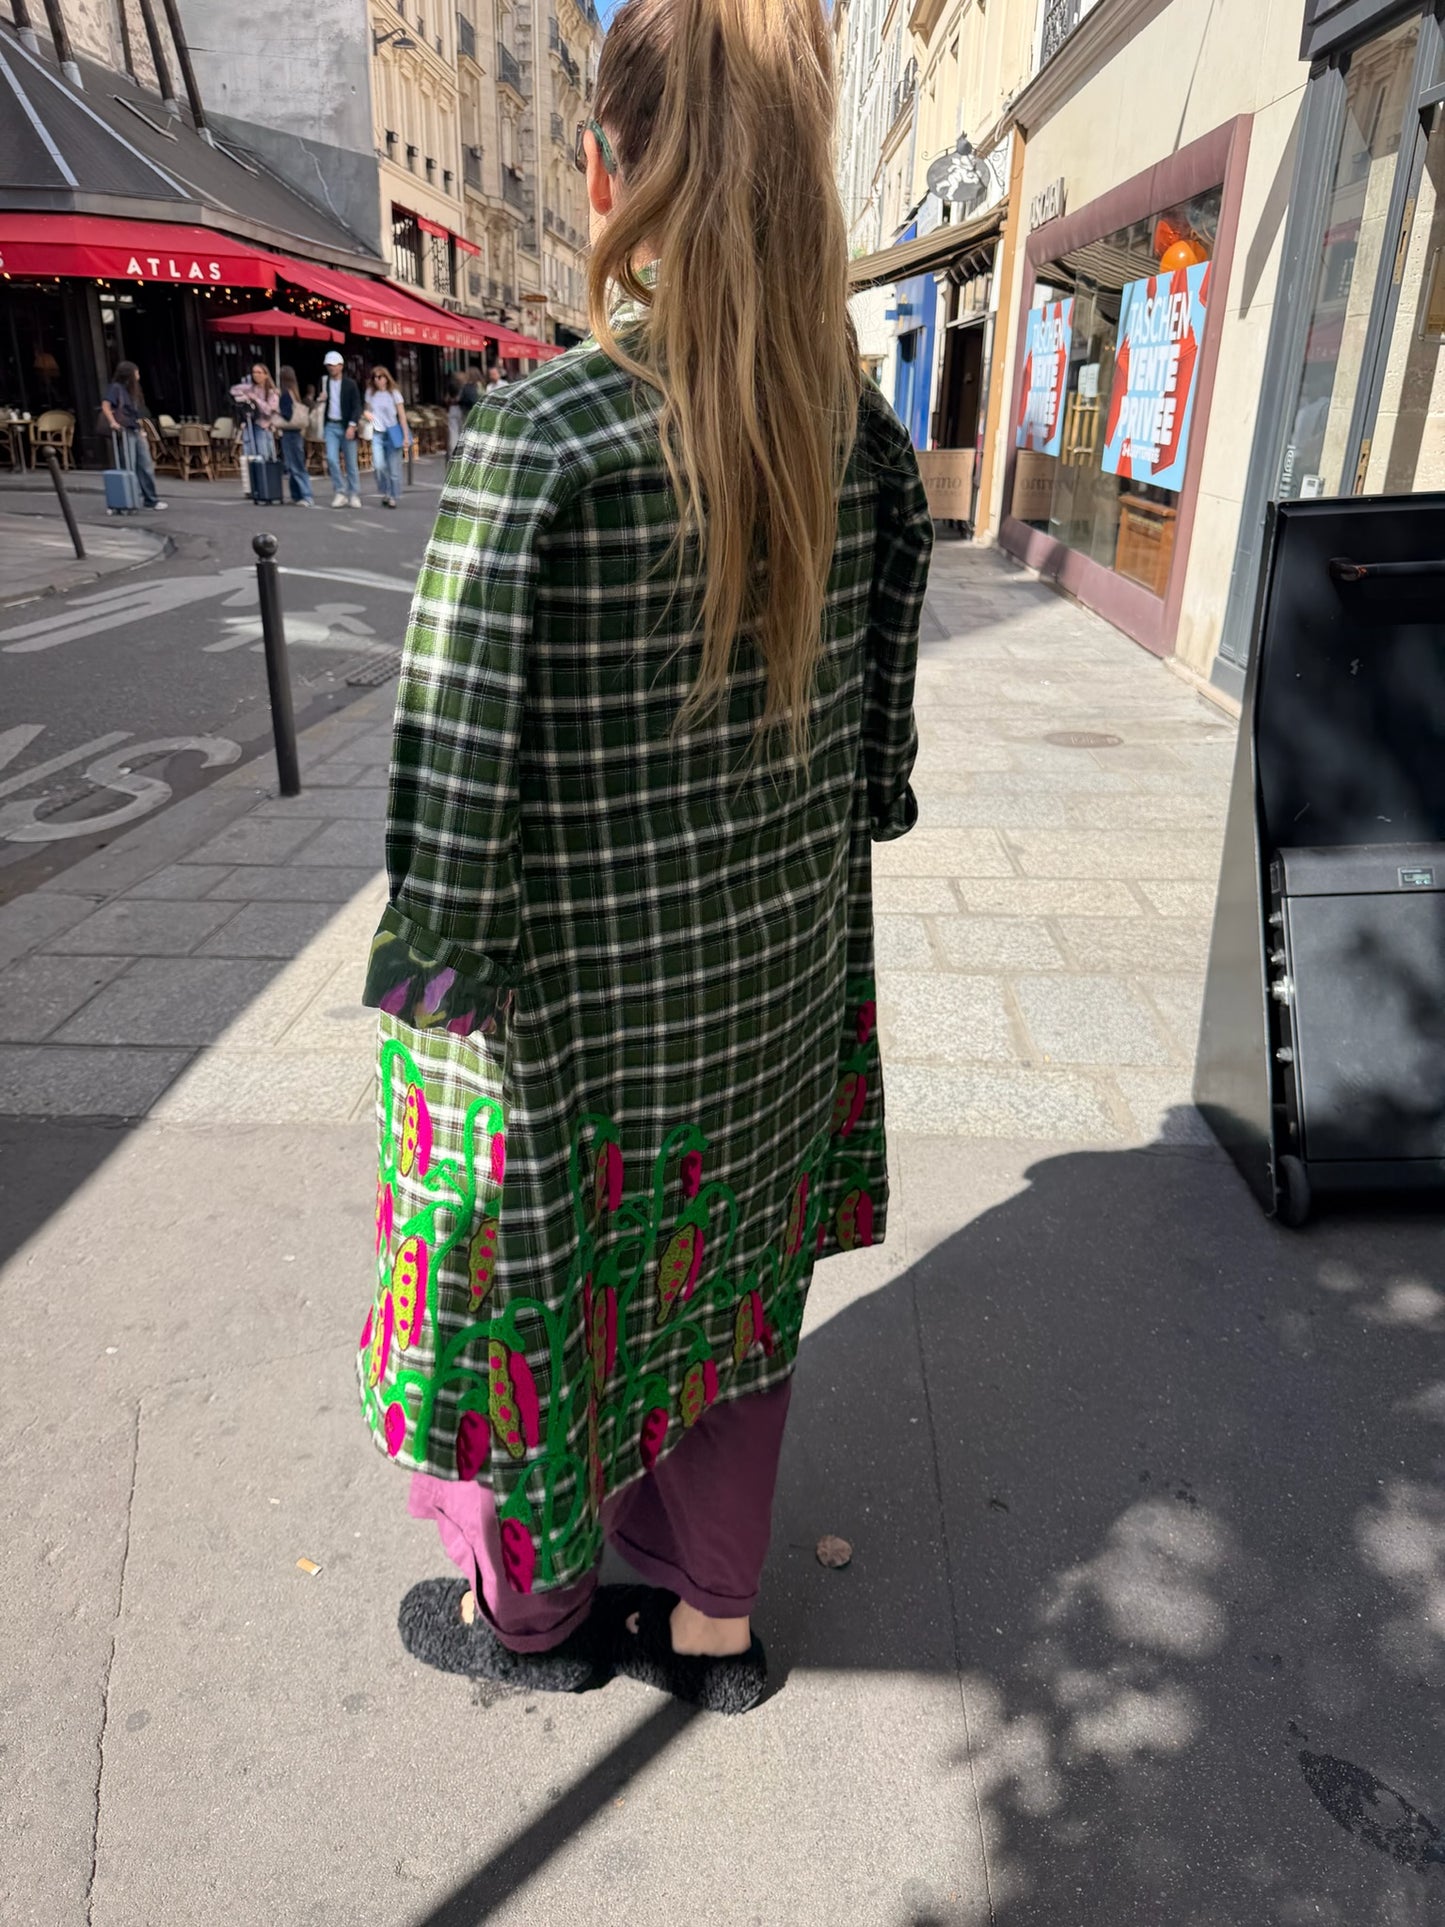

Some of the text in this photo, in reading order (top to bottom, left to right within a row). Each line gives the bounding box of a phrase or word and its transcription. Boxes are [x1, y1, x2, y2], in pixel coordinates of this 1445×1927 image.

[126, 256, 222, 281] ATLAS
[1129, 291, 1193, 345] TASCHEN
[1127, 344, 1181, 393] VENTE
[1116, 390, 1178, 447] PRIVÉE
